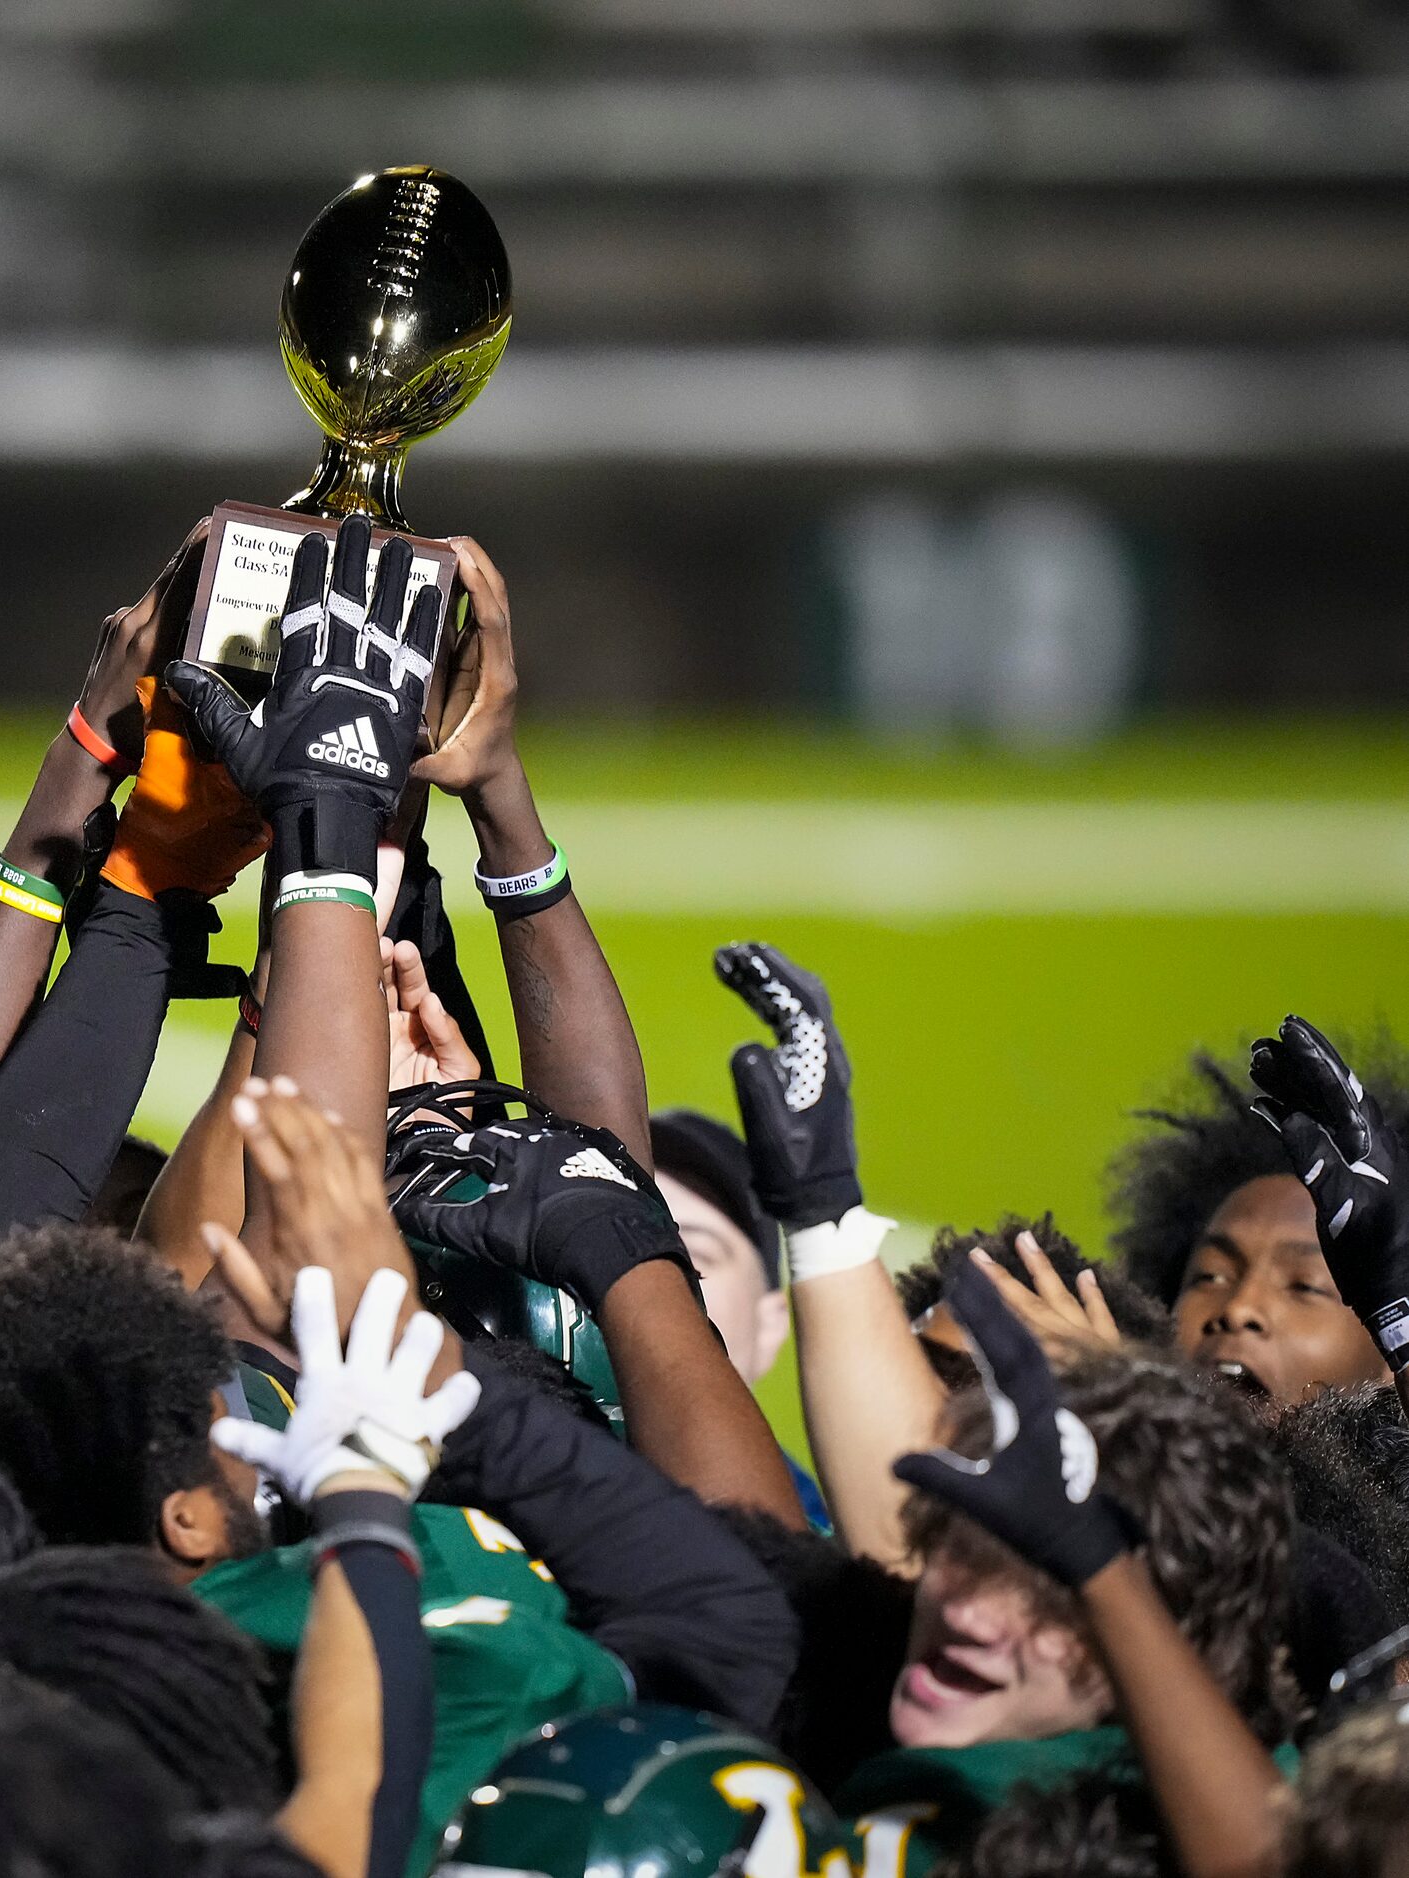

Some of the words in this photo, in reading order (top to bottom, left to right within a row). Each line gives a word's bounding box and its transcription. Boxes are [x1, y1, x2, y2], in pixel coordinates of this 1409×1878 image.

[232, 533, 265, 552] State
[234, 555, 269, 574] Class
[271, 562, 289, 577] 5A
[216, 593, 264, 611] Longview
[265, 603, 280, 614] HS
[308, 742, 389, 778] adidas
[498, 875, 538, 895] BEARS
